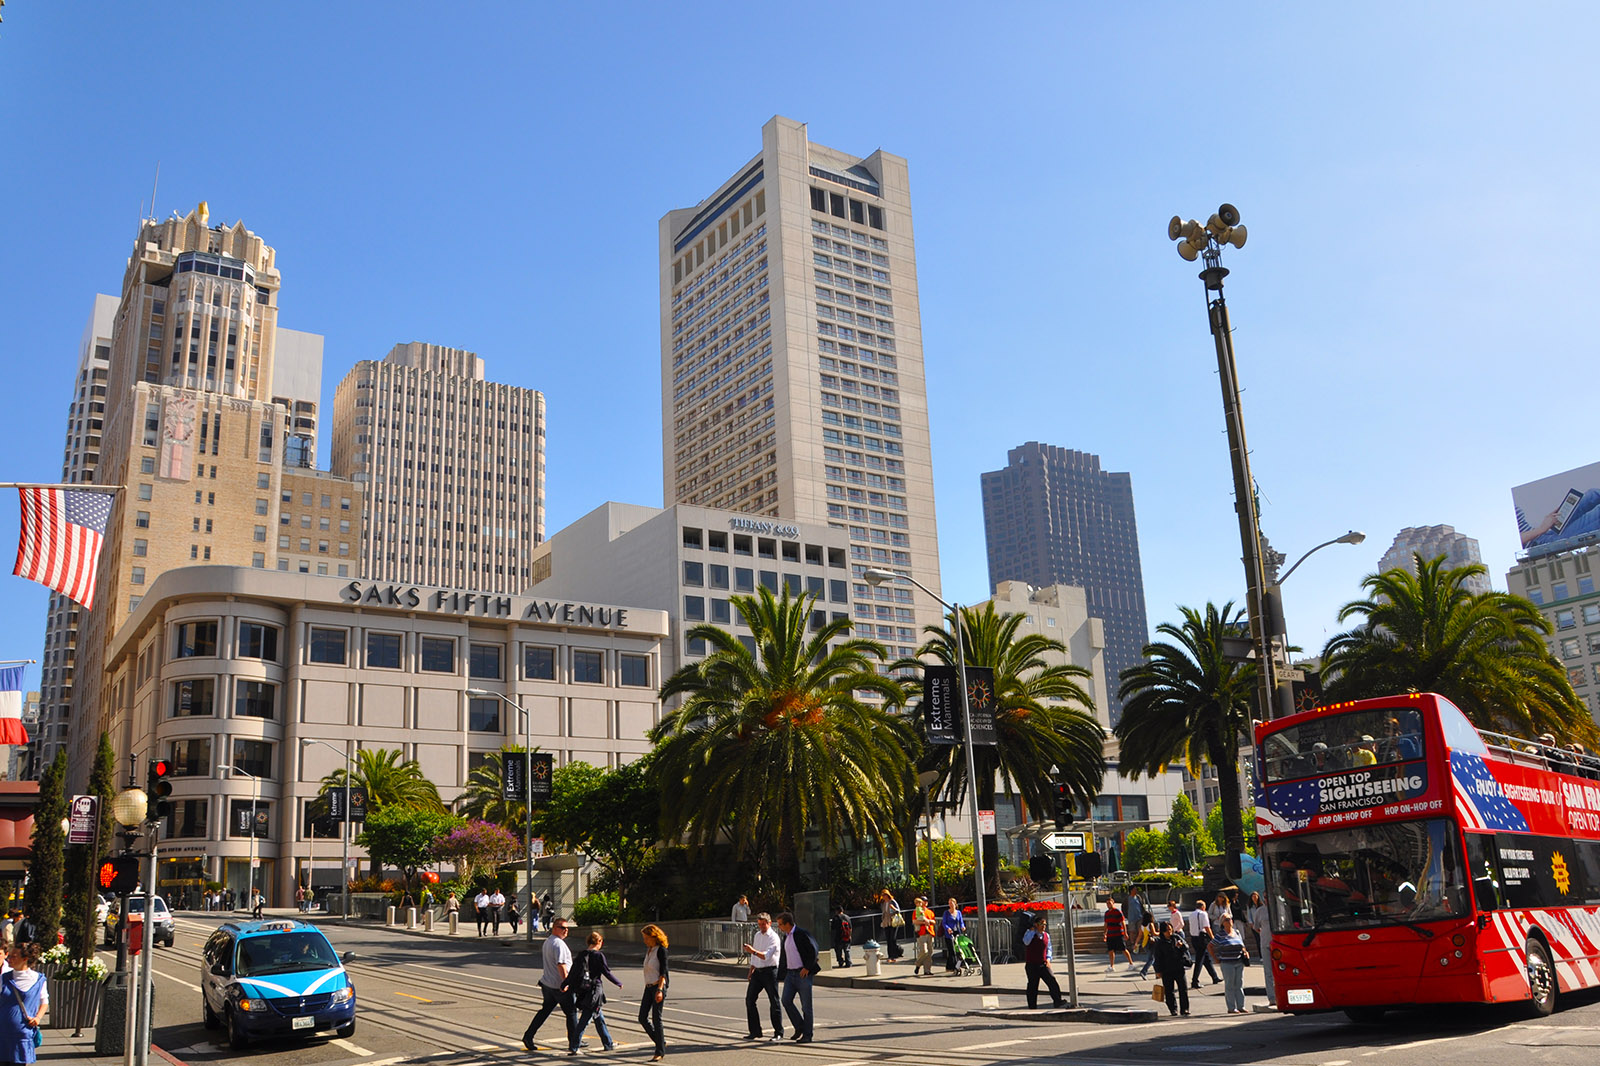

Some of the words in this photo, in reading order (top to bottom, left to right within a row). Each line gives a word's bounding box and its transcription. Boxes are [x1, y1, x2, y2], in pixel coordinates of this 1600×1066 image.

[731, 516, 774, 531] TIFFANY
[776, 523, 784, 533] &
[348, 581, 421, 607] SAKS
[436, 590, 511, 615] FIFTH
[527, 600, 628, 627] AVENUE
[1278, 671, 1300, 679] GEARY
[930, 678, 942, 731] Extreme
[941, 678, 953, 730] Mammals
[506, 759, 515, 792] Extreme
[1318, 775, 1347, 789] OPEN
[1349, 771, 1372, 784] TOP
[1319, 775, 1423, 803] SIGHTSEEING
[1475, 778, 1497, 797] ENJOY
[1497, 782, 1505, 798] A
[1504, 783, 1540, 803] SIGHTSEEING
[1539, 789, 1556, 805] TOUR
[1562, 782, 1586, 809] SAN
[331, 791, 339, 816] Extreme
[1320, 803, 1336, 813] SAN
[1338, 795, 1384, 810] FRANCISCO
[1384, 804, 1399, 815] HOP
[1400, 802, 1428, 814] ON-HOP
[1429, 799, 1443, 810] OFF
[1297, 817, 1310, 828] OFF
[1318, 815, 1332, 825] HOP
[1332, 811, 1359, 823] ON-HOP
[1360, 809, 1373, 820] OFF
[1568, 811, 1588, 830] OPEN
[1587, 812, 1600, 831] TOP
[1054, 836, 1067, 845] ONE
[1069, 836, 1081, 845] WAY
[267, 923, 288, 931] TAXI
